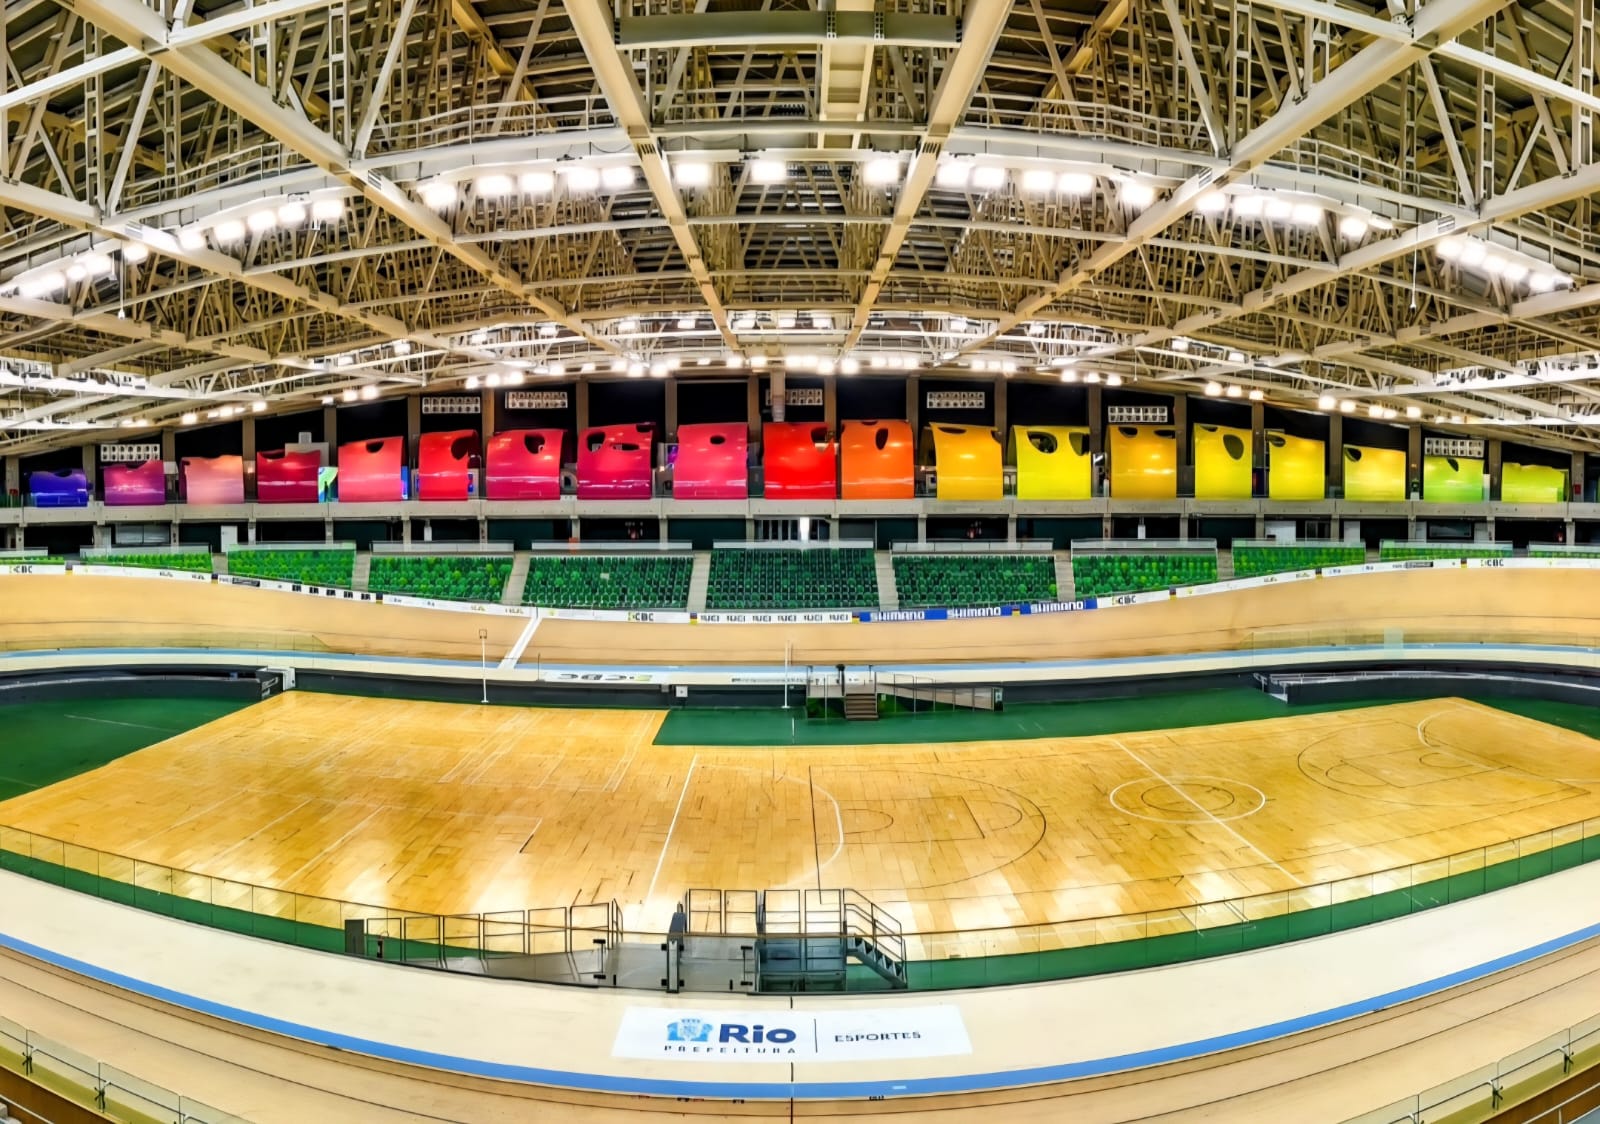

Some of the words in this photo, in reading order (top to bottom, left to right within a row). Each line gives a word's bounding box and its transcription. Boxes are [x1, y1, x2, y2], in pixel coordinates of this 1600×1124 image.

[947, 606, 1001, 618] SHIMANO
[1030, 601, 1084, 613] SHIMANO
[870, 610, 925, 621] SHIMANO
[719, 1023, 797, 1044] Rio
[835, 1031, 922, 1043] ESPORTES
[664, 1044, 796, 1055] PREFEITURA
